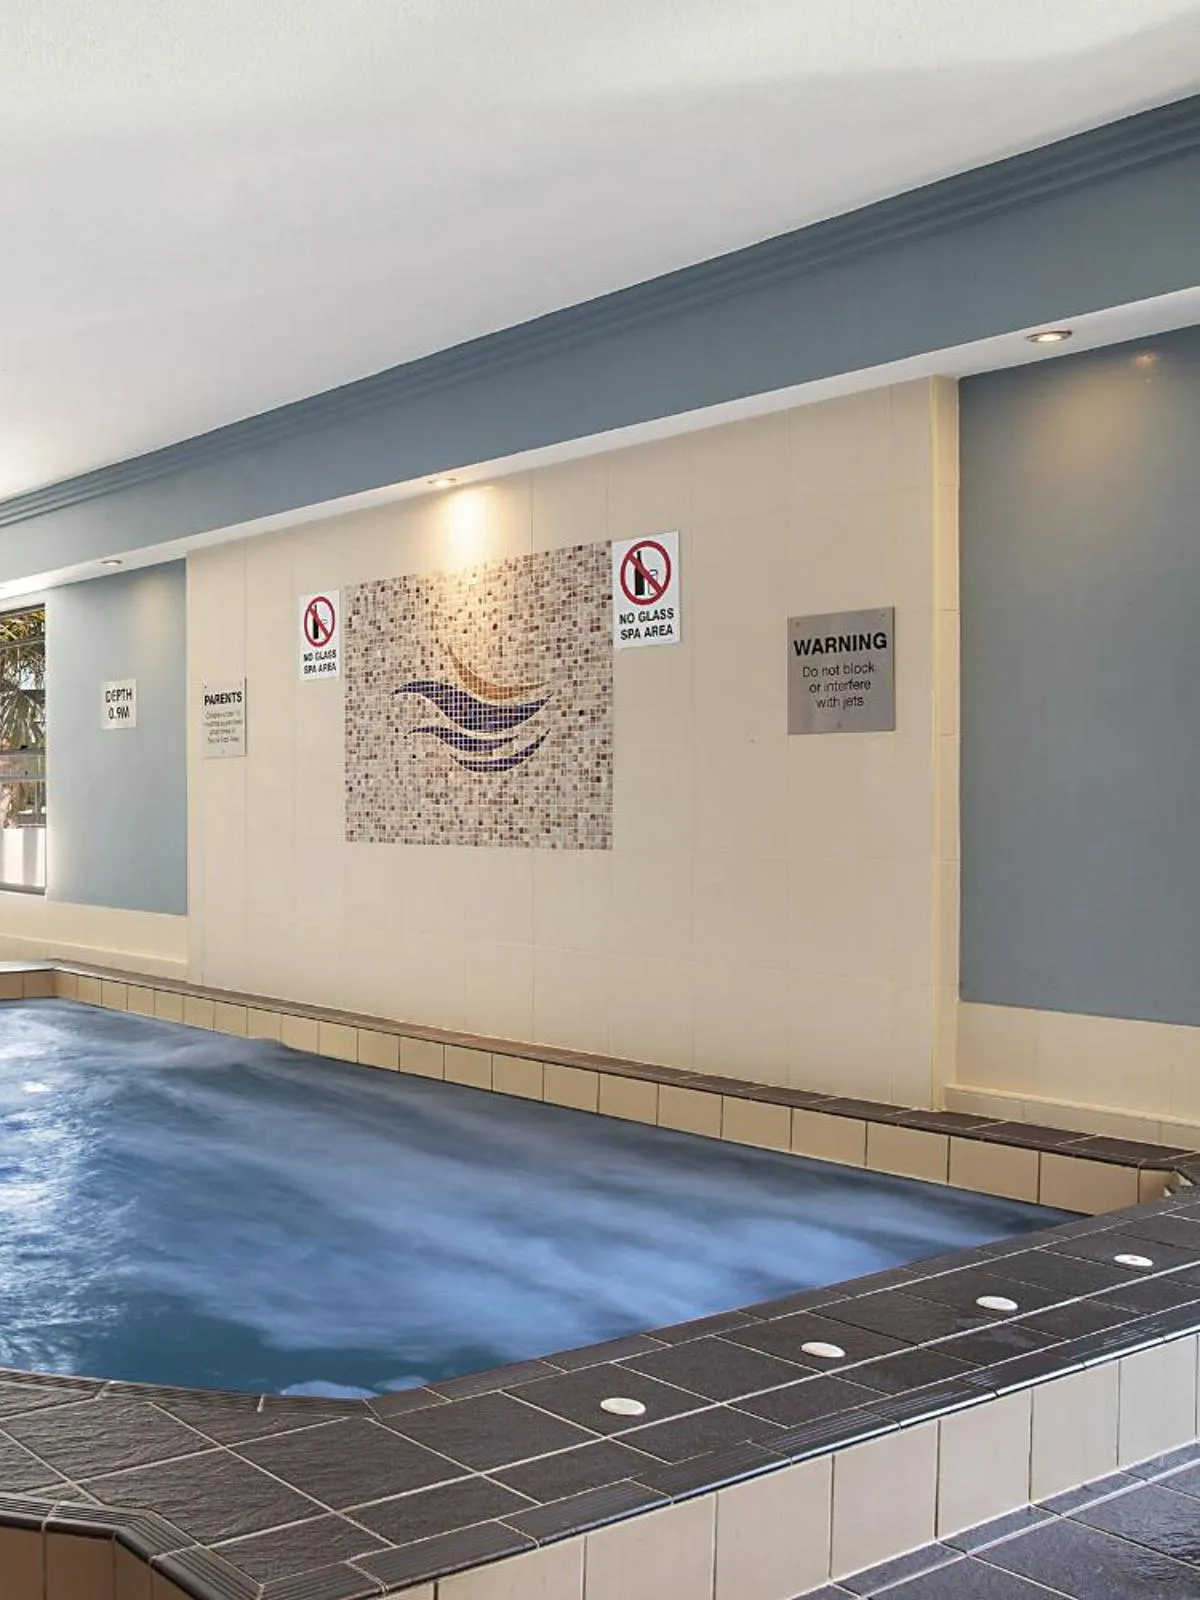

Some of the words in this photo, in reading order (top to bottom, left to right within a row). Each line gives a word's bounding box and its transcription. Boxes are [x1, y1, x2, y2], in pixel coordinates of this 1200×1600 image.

[619, 612, 635, 624] NO
[638, 607, 675, 623] GLASS
[620, 628, 641, 640] SPA
[644, 624, 673, 637] AREA
[793, 632, 887, 656] WARNING
[303, 652, 313, 662] NO
[315, 649, 337, 661] GLASS
[303, 665, 316, 674] SPA
[318, 662, 337, 672] AREA
[802, 666, 818, 678] Do
[822, 665, 839, 677] not
[843, 661, 875, 675] block
[809, 683, 821, 693] or
[824, 678, 871, 692] interfere
[105, 688, 132, 703] DEPTH
[204, 691, 242, 706] PARENTS
[816, 696, 840, 708] with
[842, 695, 864, 710] jets
[108, 706, 130, 720] 0.9M
